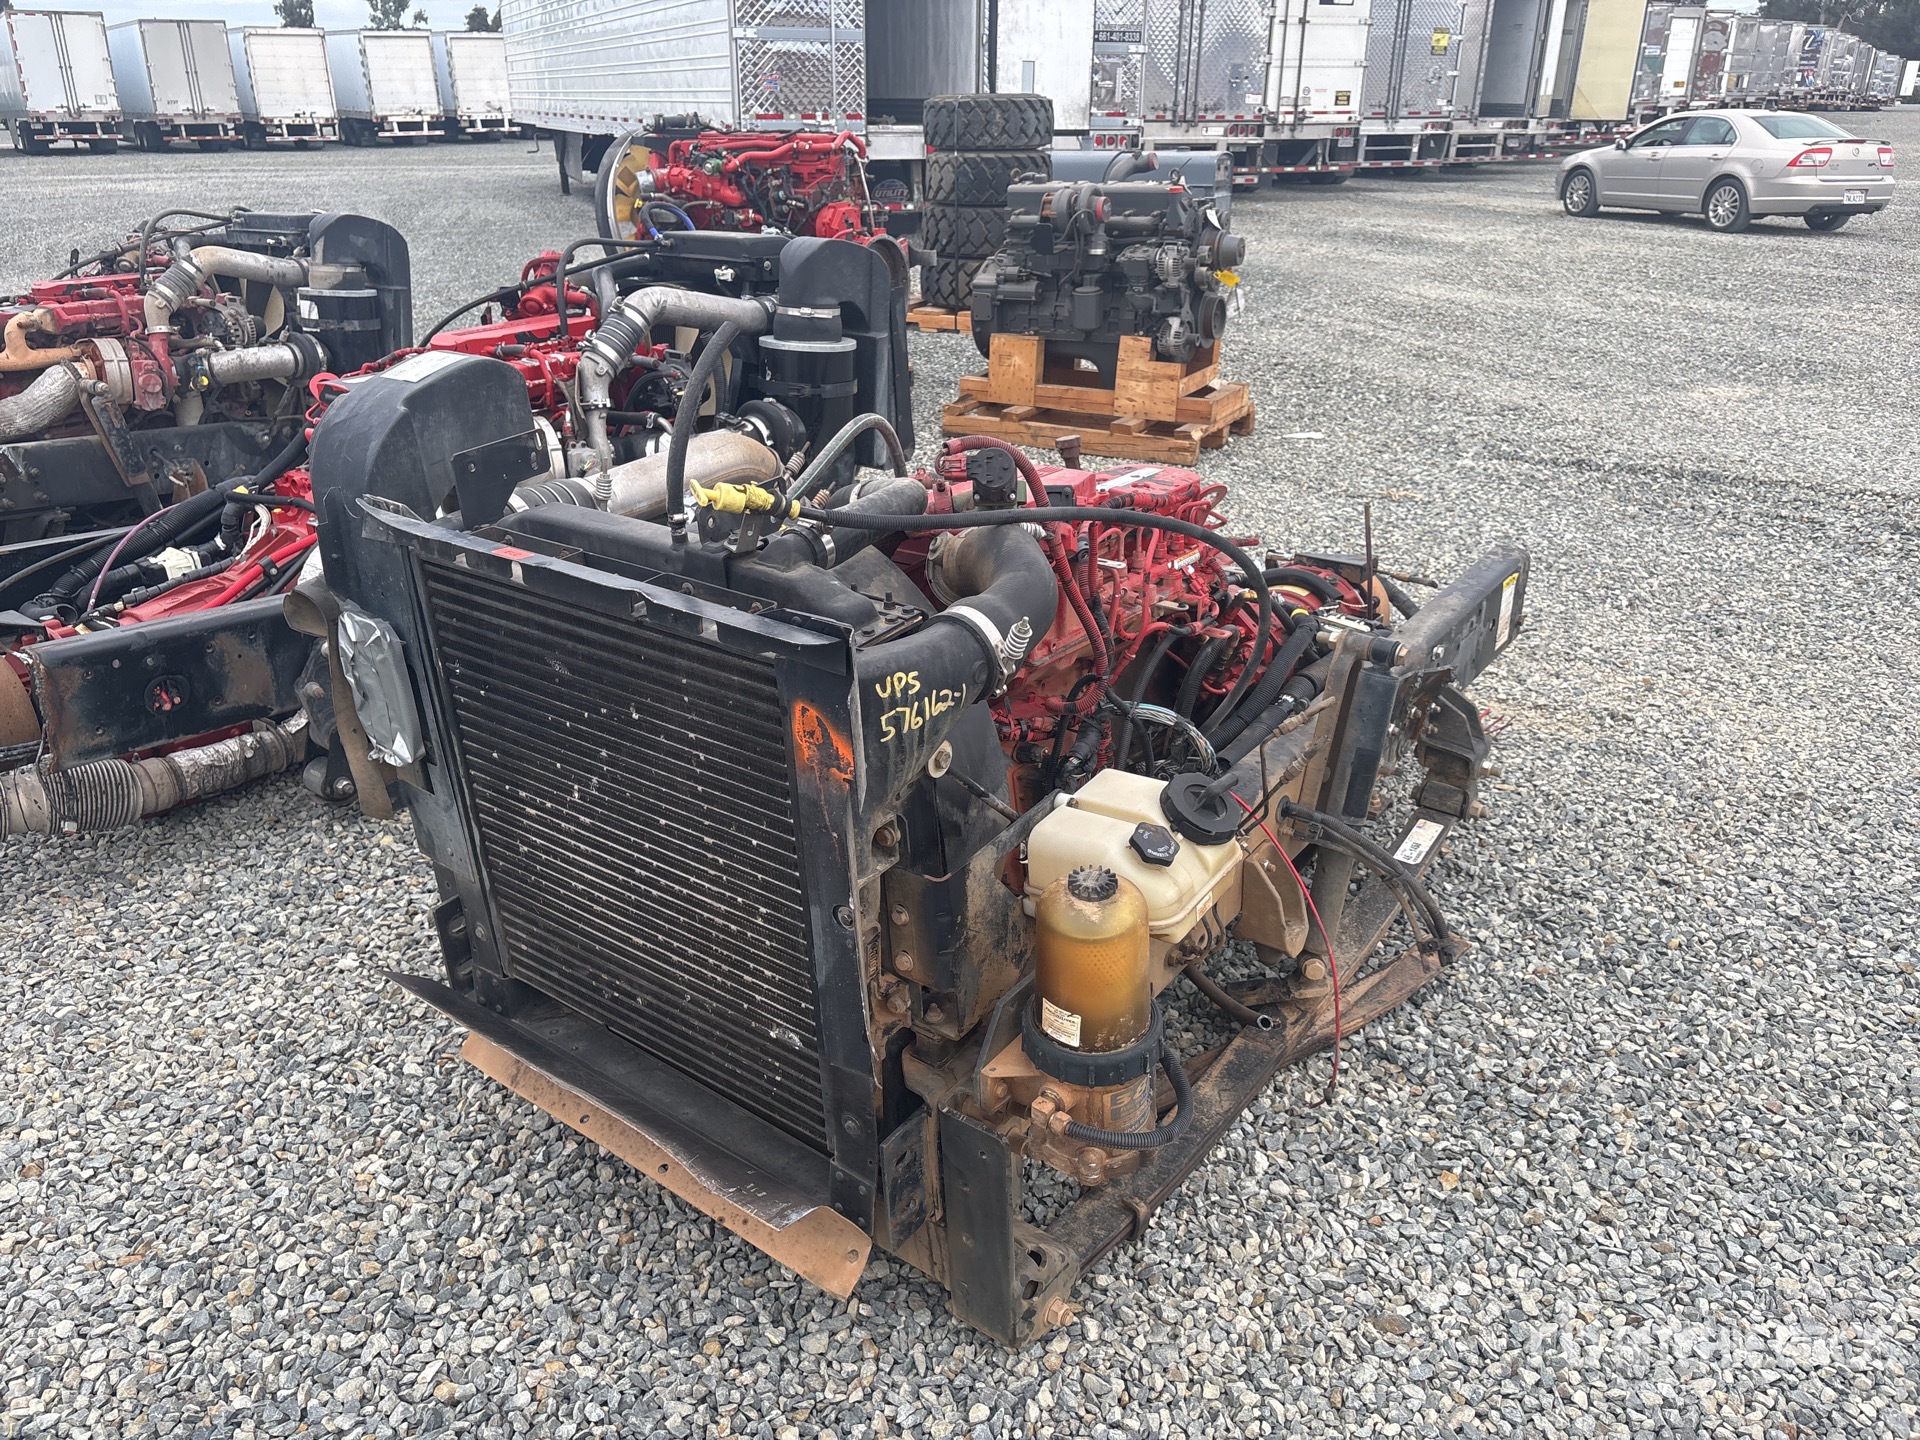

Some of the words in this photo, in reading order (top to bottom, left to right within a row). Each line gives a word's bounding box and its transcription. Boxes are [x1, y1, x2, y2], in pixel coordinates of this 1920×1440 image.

[874, 188, 909, 198] UTILITY
[875, 671, 921, 699] UPS
[879, 682, 967, 743] 576162-1
